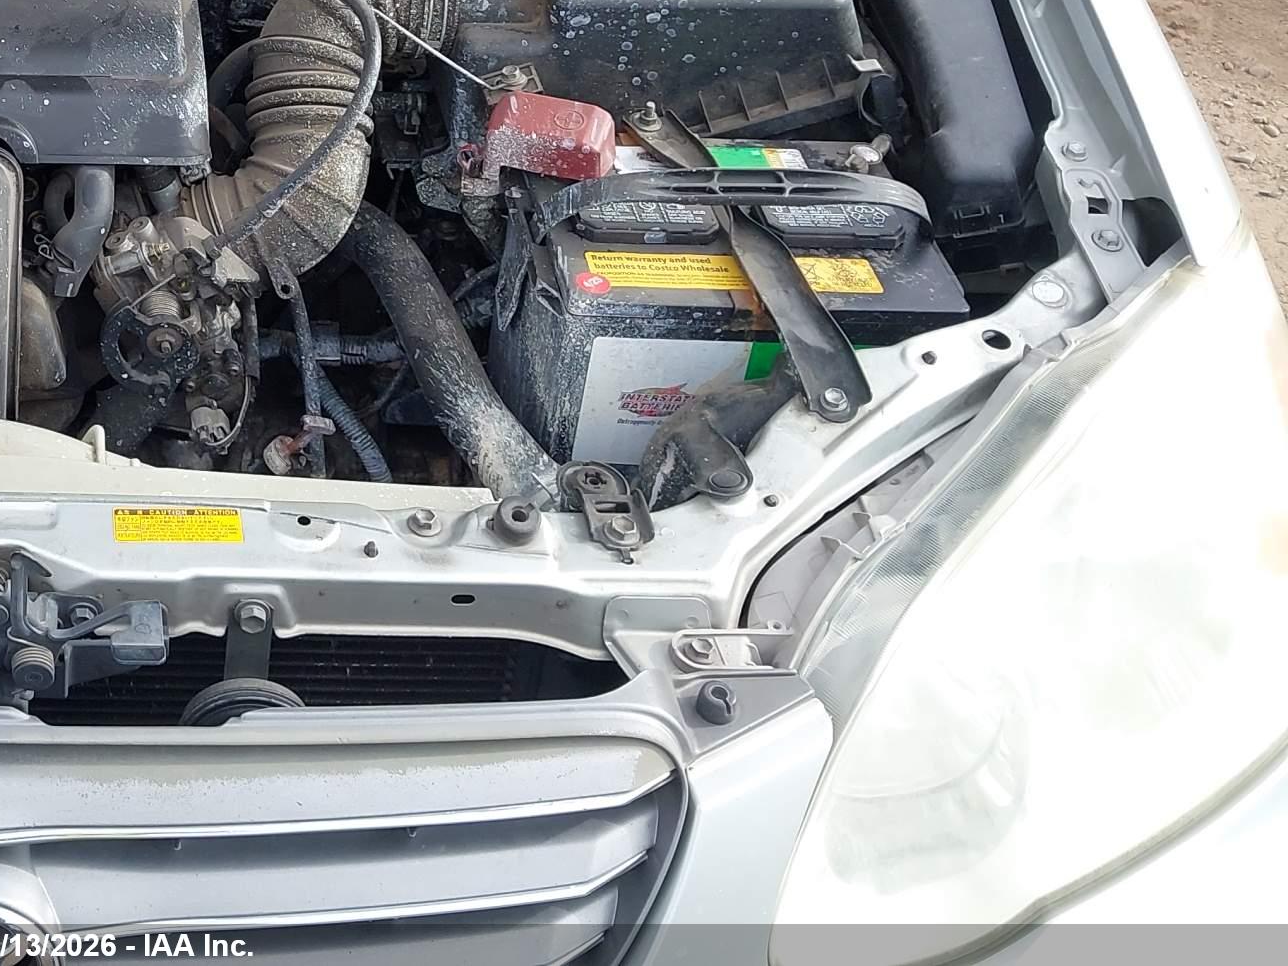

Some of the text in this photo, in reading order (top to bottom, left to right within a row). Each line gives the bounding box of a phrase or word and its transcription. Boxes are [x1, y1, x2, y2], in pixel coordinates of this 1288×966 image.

[591, 254, 712, 265] Return warranty and used
[594, 262, 635, 271] batteries
[649, 264, 679, 272] Costco
[680, 264, 730, 273] Wholesale
[620, 393, 696, 403] INTERSTAT
